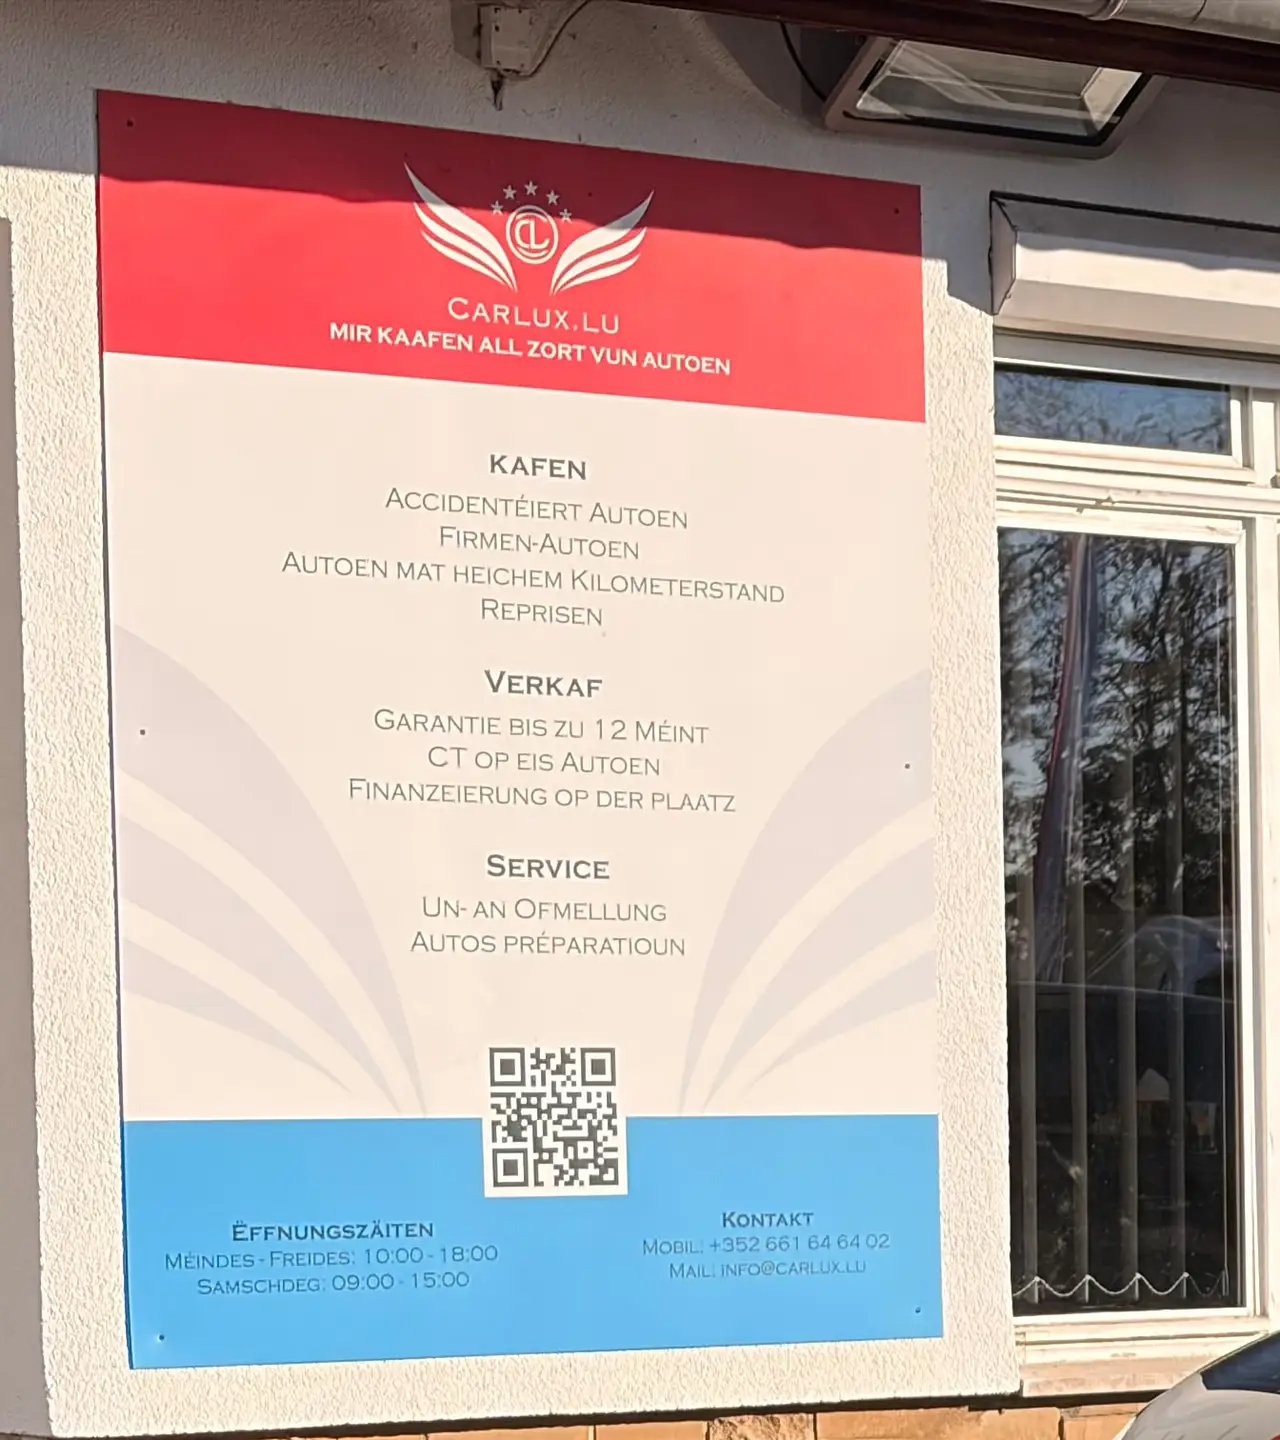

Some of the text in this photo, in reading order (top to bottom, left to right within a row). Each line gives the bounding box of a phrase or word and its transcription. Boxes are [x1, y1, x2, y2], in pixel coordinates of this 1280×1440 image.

[331, 323, 730, 375] MIR KAAFEN ALL ZORT VUN AUTOEN
[491, 455, 586, 480] KAFEN
[397, 562, 445, 581] MAT
[454, 565, 562, 589] HEICHEM
[510, 718, 547, 736] BIS
[554, 720, 583, 738] ZU
[597, 719, 627, 740] 12
[428, 746, 467, 768] CT
[475, 751, 509, 770] OP
[518, 753, 553, 771] EIS
[555, 789, 588, 806] OP
[597, 791, 643, 809] DER
[473, 901, 505, 918] AN
[710, 1236, 760, 1252] +352
[766, 1235, 798, 1251] 661
[808, 1235, 830, 1250] 64
[837, 1233, 860, 1249] 64
[866, 1233, 890, 1250] 02
[365, 1247, 423, 1264] 10:00
[441, 1245, 497, 1263] 18:00
[332, 1273, 394, 1290] 09:00
[412, 1271, 469, 1288] 15:00
